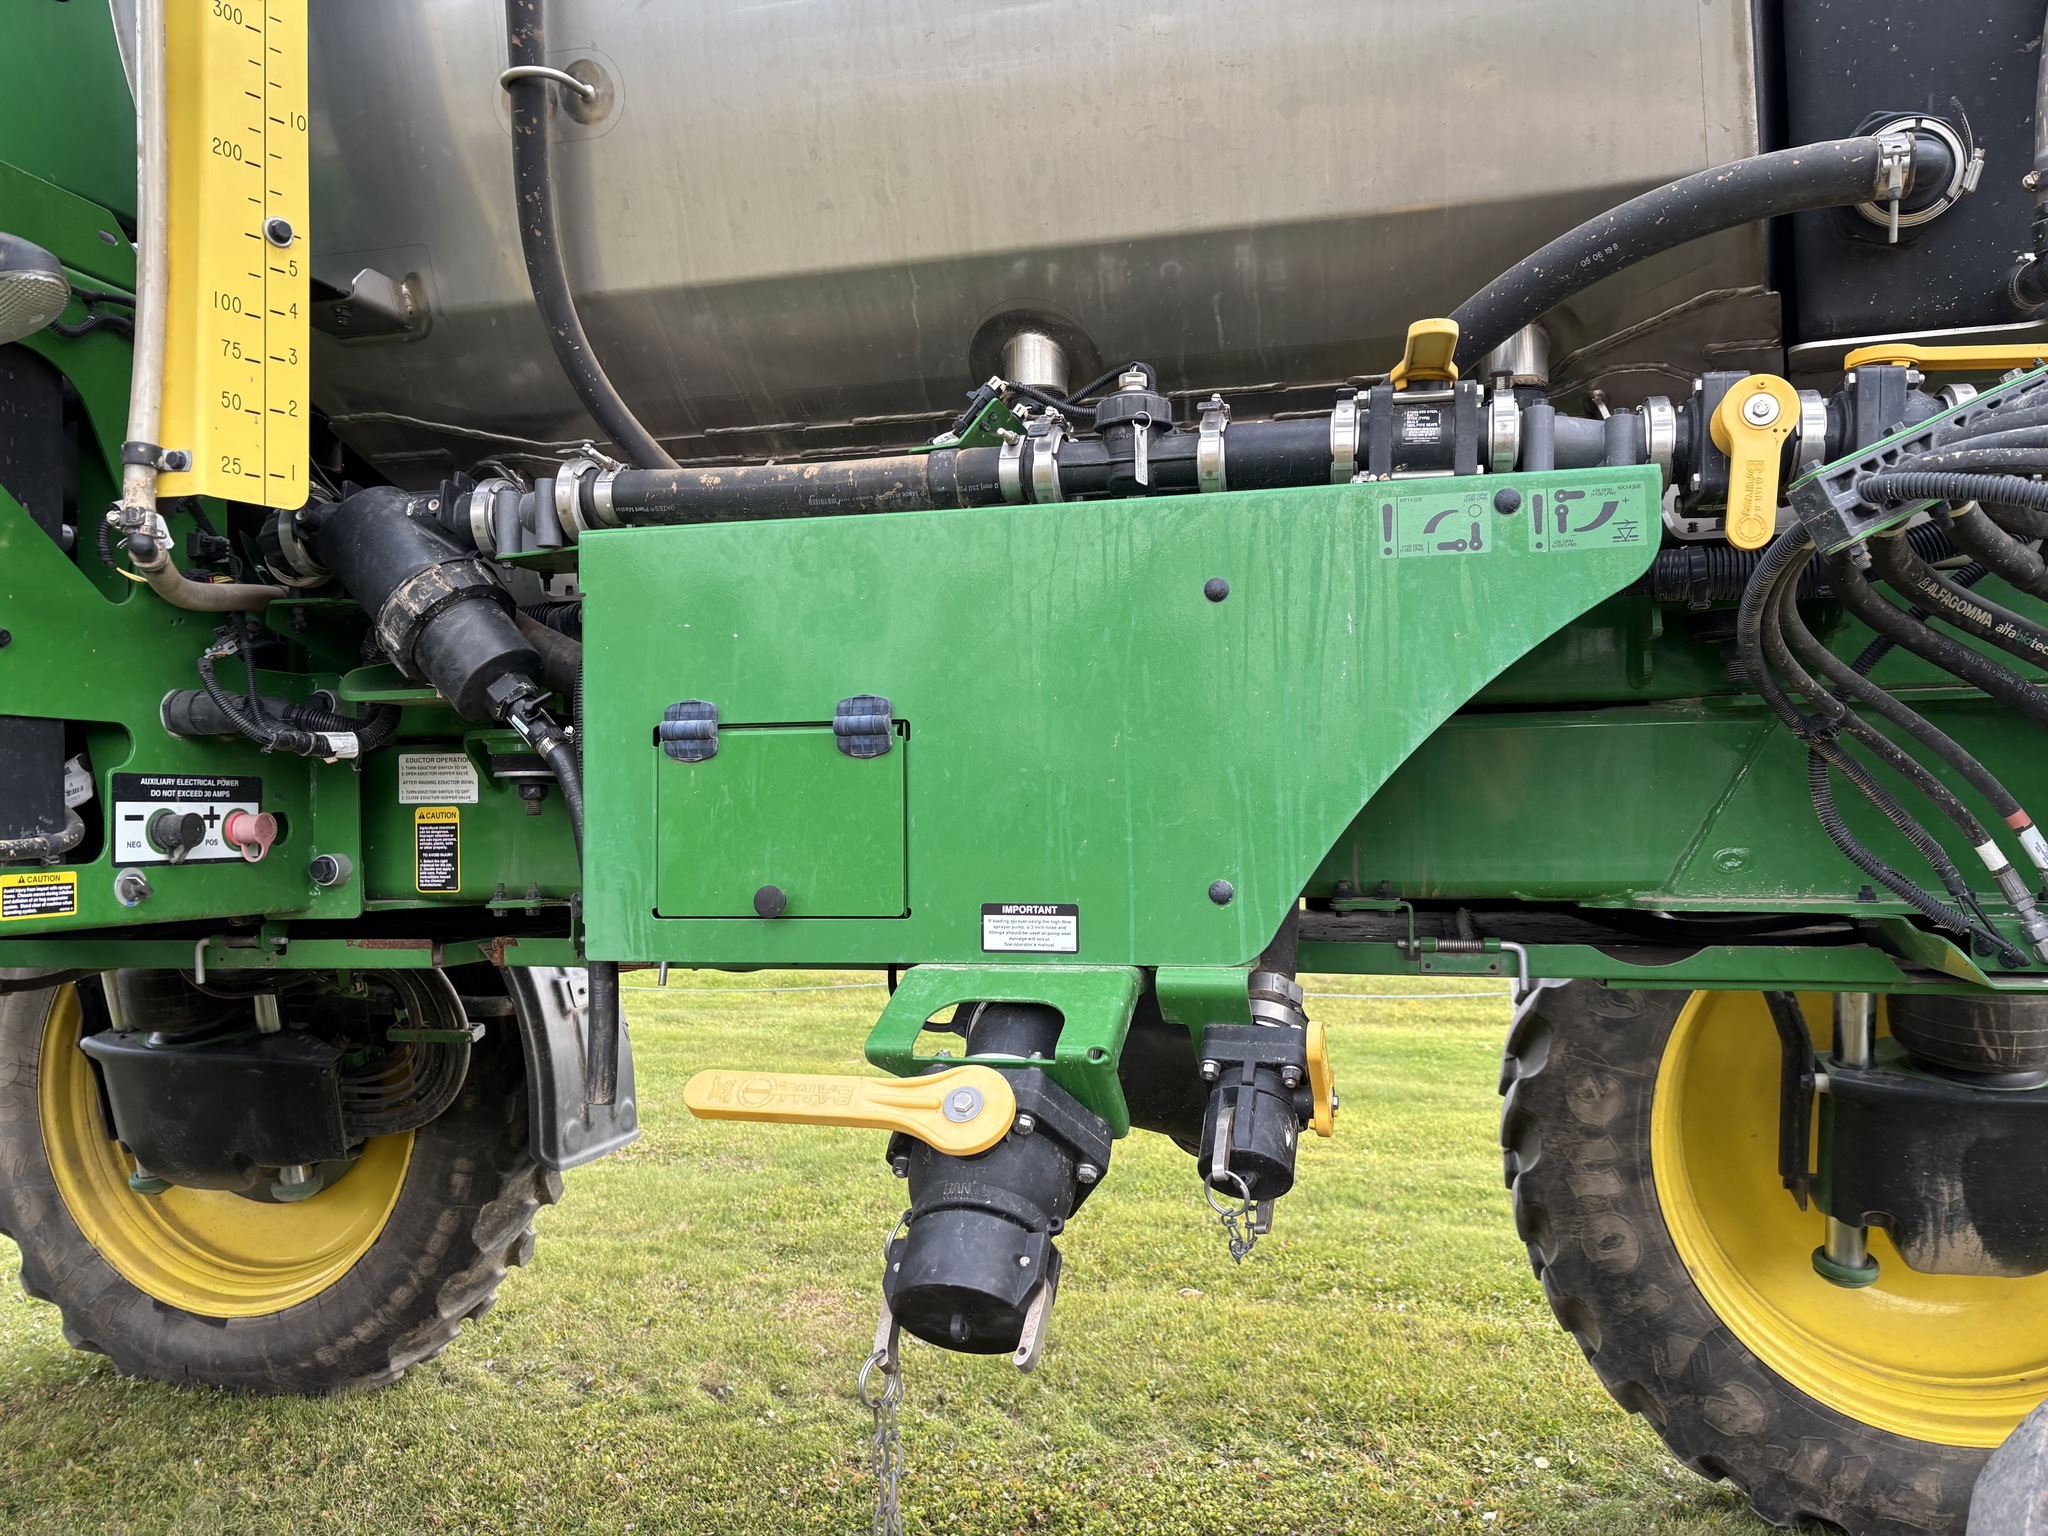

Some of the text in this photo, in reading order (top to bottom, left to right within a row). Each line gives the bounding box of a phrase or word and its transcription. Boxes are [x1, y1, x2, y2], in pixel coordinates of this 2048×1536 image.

[213, 0, 242, 25] 300
[290, 112, 306, 132] 10
[212, 137, 242, 161] 200
[1592, 251, 1603, 261] 06
[289, 260, 298, 277] 5
[214, 291, 242, 314] 100
[289, 303, 298, 319] 4
[221, 339, 242, 359] 75
[289, 348, 298, 365] 3
[221, 391, 242, 411] 50
[289, 400, 298, 417] 2
[221, 456, 242, 475] 25
[291, 464, 295, 481] 1
[1924, 582, 1993, 628] ALFAGOMMA
[1995, 622, 2048, 655] alfabiotec
[1982, 662, 1992, 672] IN
[1996, 670, 2015, 685] MADE
[27, 875, 61, 883] CAUTION
[1002, 905, 1058, 914] IMPORTANT
